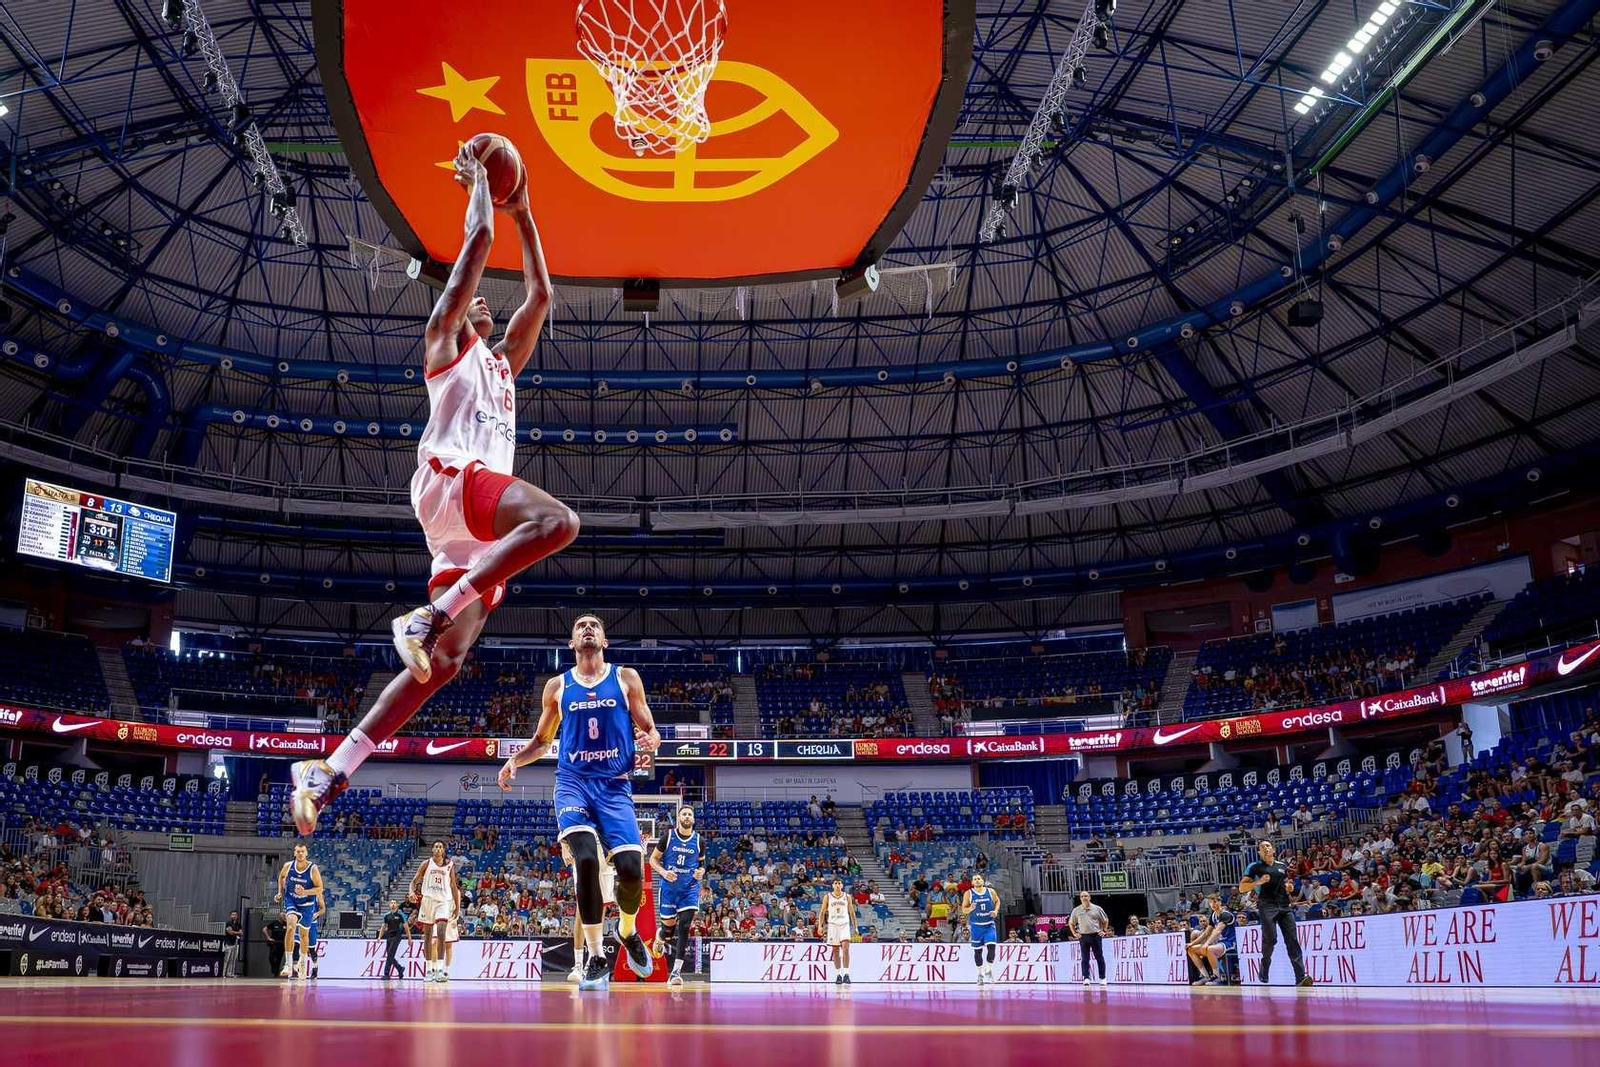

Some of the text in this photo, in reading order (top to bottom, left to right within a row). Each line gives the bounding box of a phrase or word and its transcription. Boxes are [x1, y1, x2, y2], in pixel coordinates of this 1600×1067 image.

[545, 73, 579, 121] FEB
[502, 388, 513, 412] 6
[87, 497, 95, 507] 8
[110, 503, 123, 513] 13
[143, 512, 171, 523] CHEQUIA
[89, 524, 113, 538] 3:01
[80, 547, 87, 555] 2
[108, 552, 115, 560] 3
[1470, 667, 1526, 691] tenerife!
[568, 699, 617, 712] ČESKO
[1384, 691, 1439, 711] CaixaBank
[1282, 710, 1342, 728] endesa
[588, 717, 599, 740] 8
[176, 733, 232, 747] endesa
[270, 737, 320, 750] CaixaBank
[896, 742, 950, 754] endesa
[987, 740, 1038, 752] CaixaBank
[551, 745, 558, 754] B
[579, 747, 619, 762] Tipsport
[709, 743, 728, 756] 22
[747, 743, 764, 756] 13
[796, 744, 842, 755] CHEQUIA
[676, 854, 686, 866] 31
[1402, 908, 1497, 948] WE ARE
[1548, 899, 1599, 940] WE
[51, 929, 76, 943] endesa
[1241, 928, 1262, 954] AR
[1297, 920, 1366, 951] WE ARE
[481, 942, 514, 960] WE
[763, 944, 795, 962] WE
[880, 944, 961, 962] WE ARE
[999, 944, 1060, 962] WE ARE
[1113, 938, 1127, 960] WE
[1129, 937, 1149, 959] ARE
[1166, 934, 1182, 958] WE
[408, 960, 427, 978] IN
[478, 961, 518, 979] ALL
[761, 963, 827, 980] ALL IN
[879, 964, 946, 981] ALL IN
[998, 964, 1057, 981] ALL IN
[1115, 961, 1131, 982] ALL
[1133, 960, 1144, 982] IN
[1167, 960, 1188, 982] ALL
[1337, 954, 1357, 983] IN
[1406, 950, 1484, 983] ALL IN
[1554, 944, 1600, 983] AL
